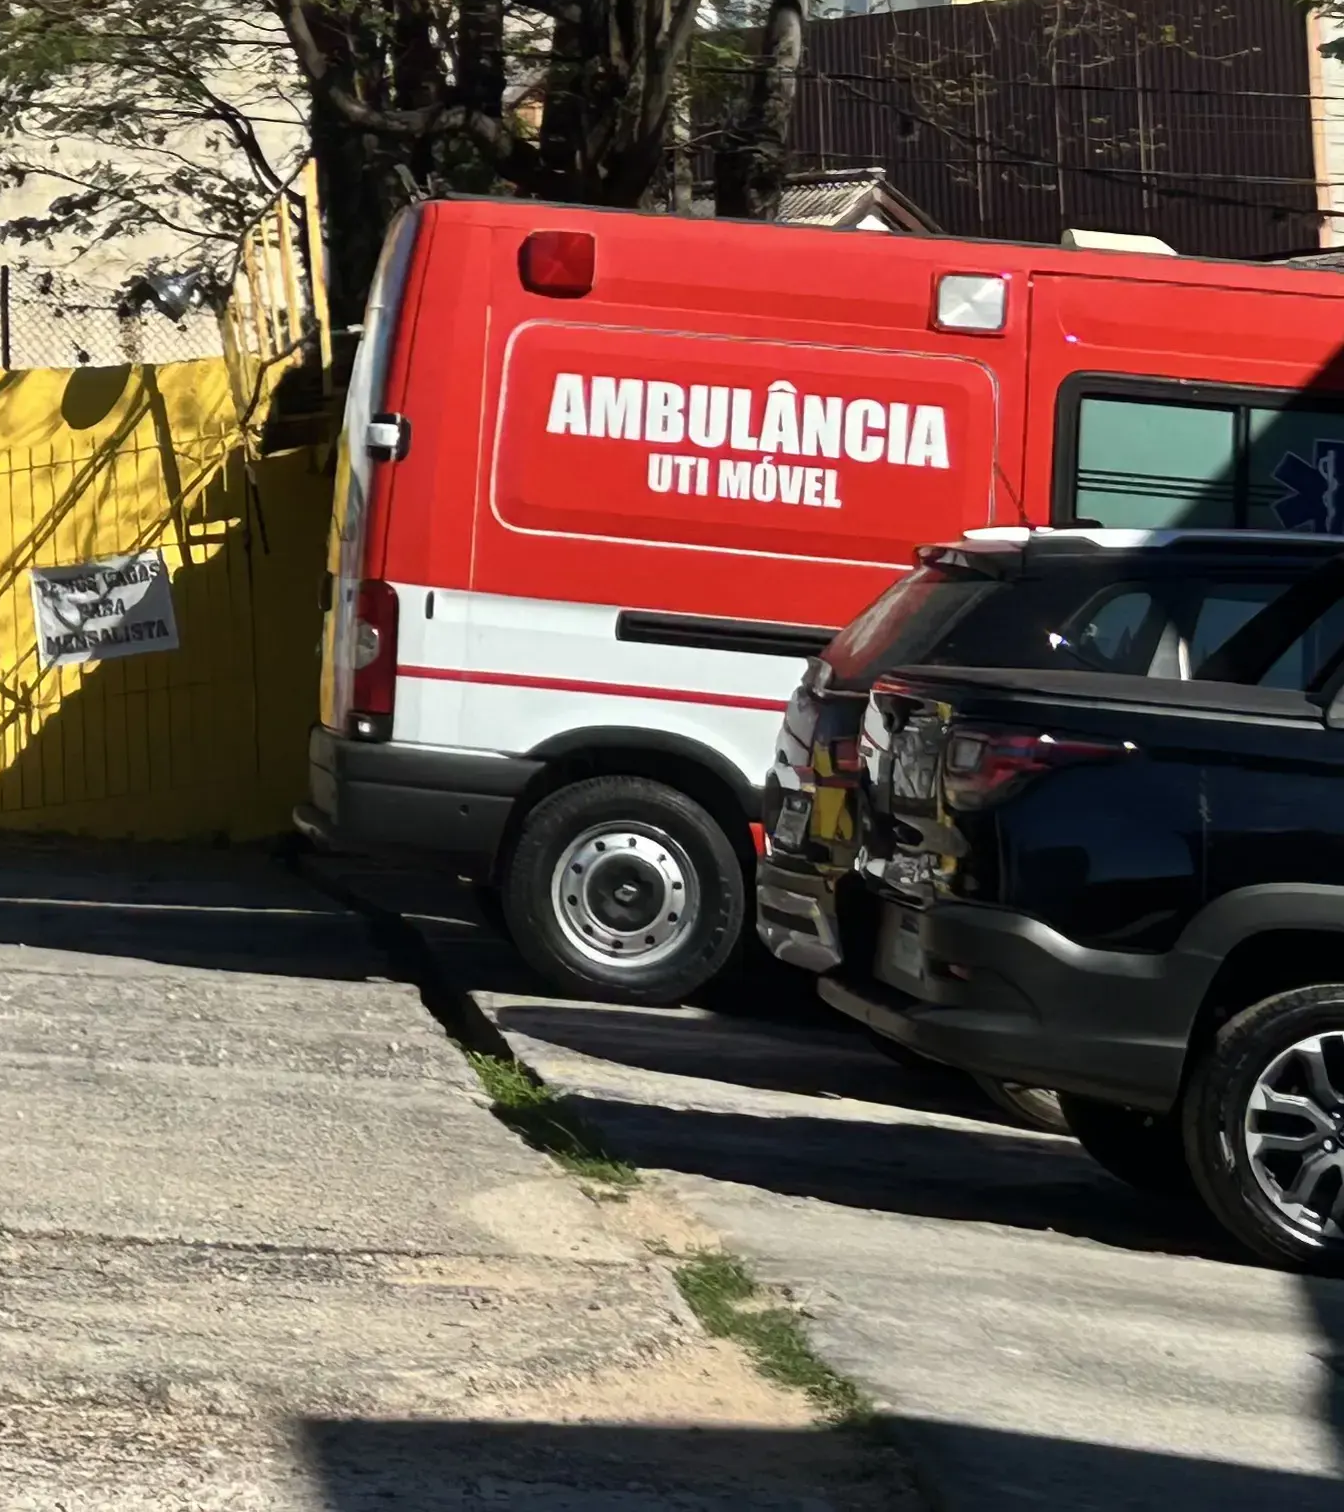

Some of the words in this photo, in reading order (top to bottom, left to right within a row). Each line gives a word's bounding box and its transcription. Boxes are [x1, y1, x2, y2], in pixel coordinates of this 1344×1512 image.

[545, 372, 950, 469] AMBULÂNCIA
[647, 452, 710, 496] UTI
[717, 455, 842, 509] MÓVEL
[45, 618, 170, 656] MENSALISTA
